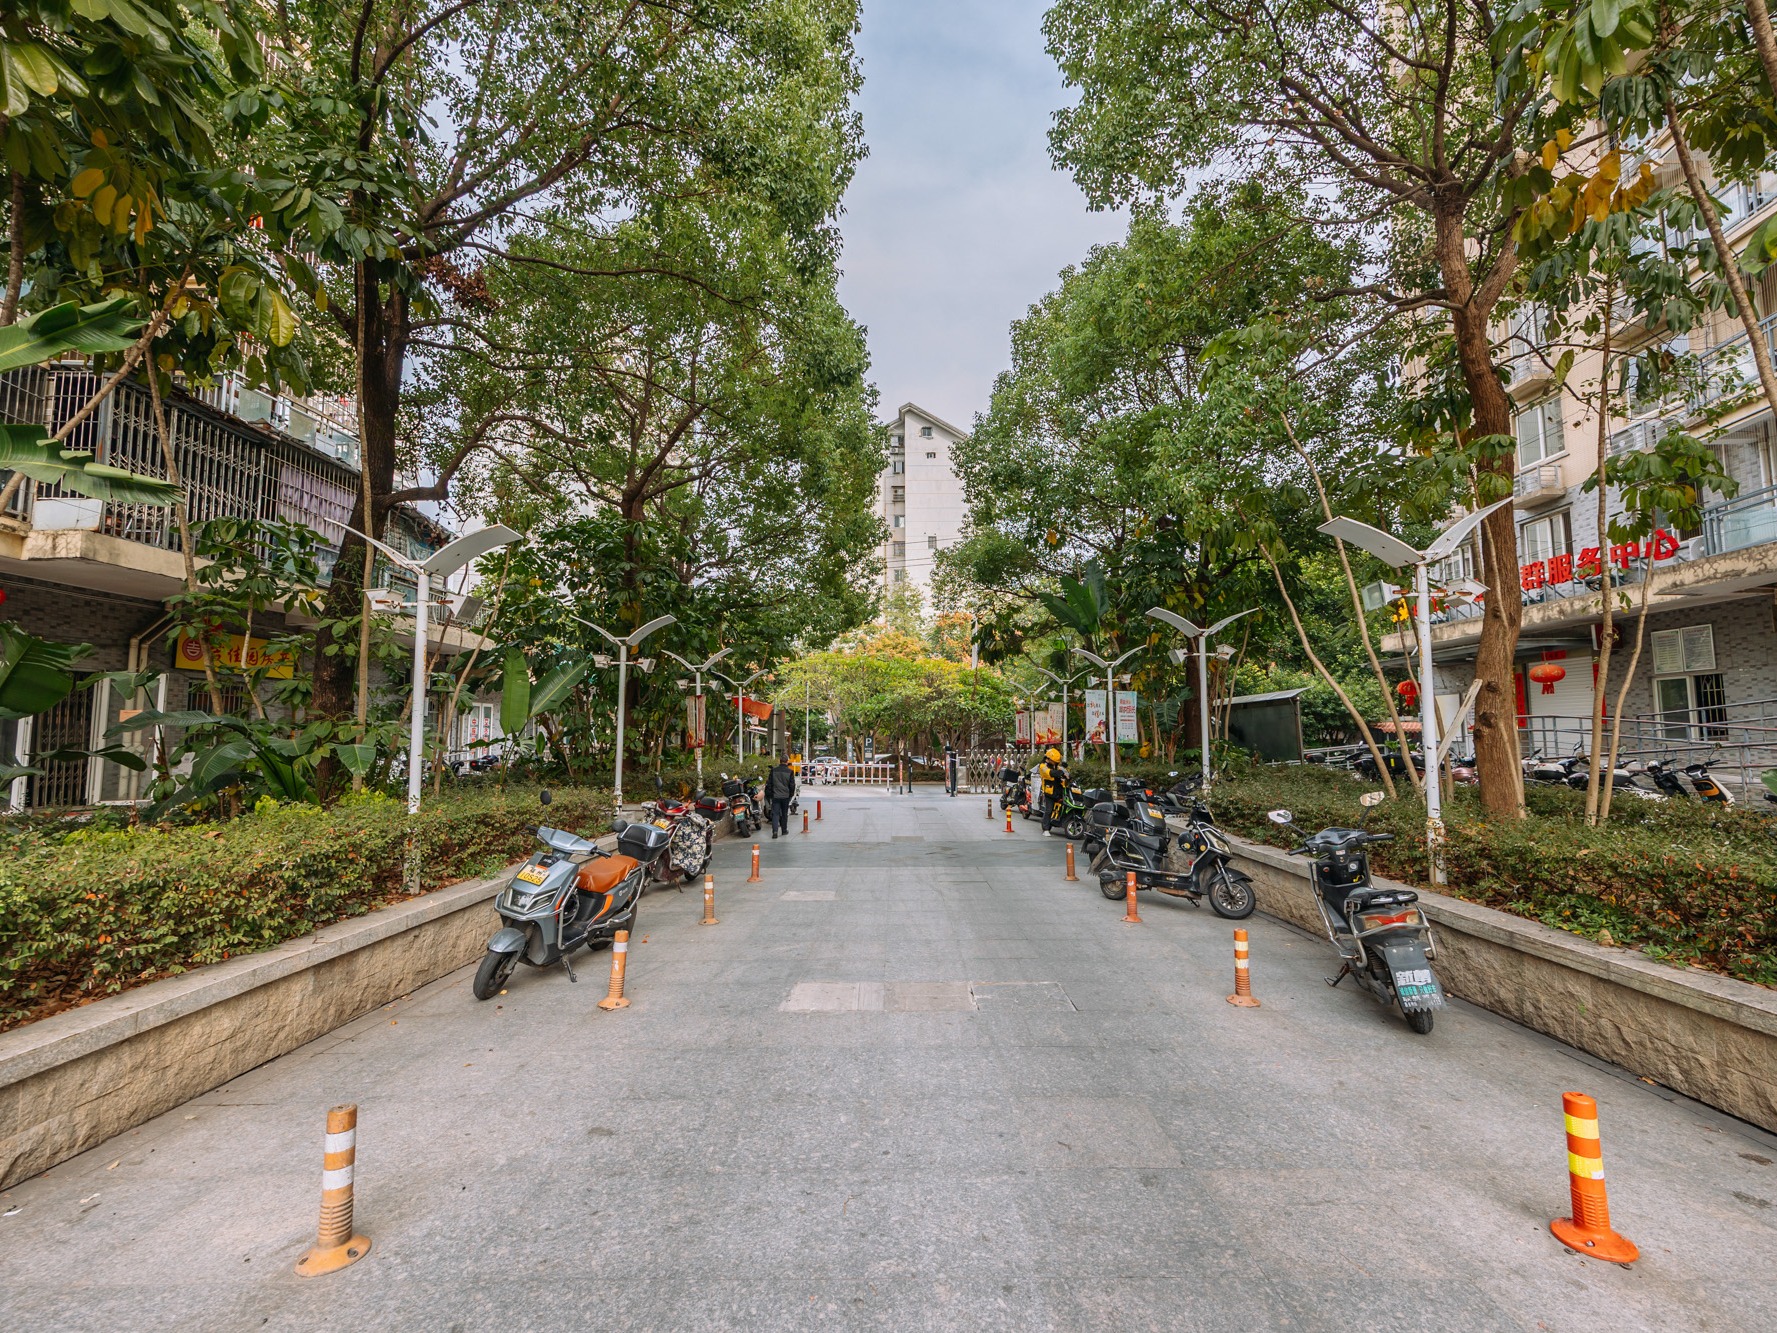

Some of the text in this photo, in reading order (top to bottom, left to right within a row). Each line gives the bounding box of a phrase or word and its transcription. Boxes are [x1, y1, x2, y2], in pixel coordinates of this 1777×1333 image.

[1520, 529, 1680, 590] 群服务中心
[866, 738, 872, 746] P
